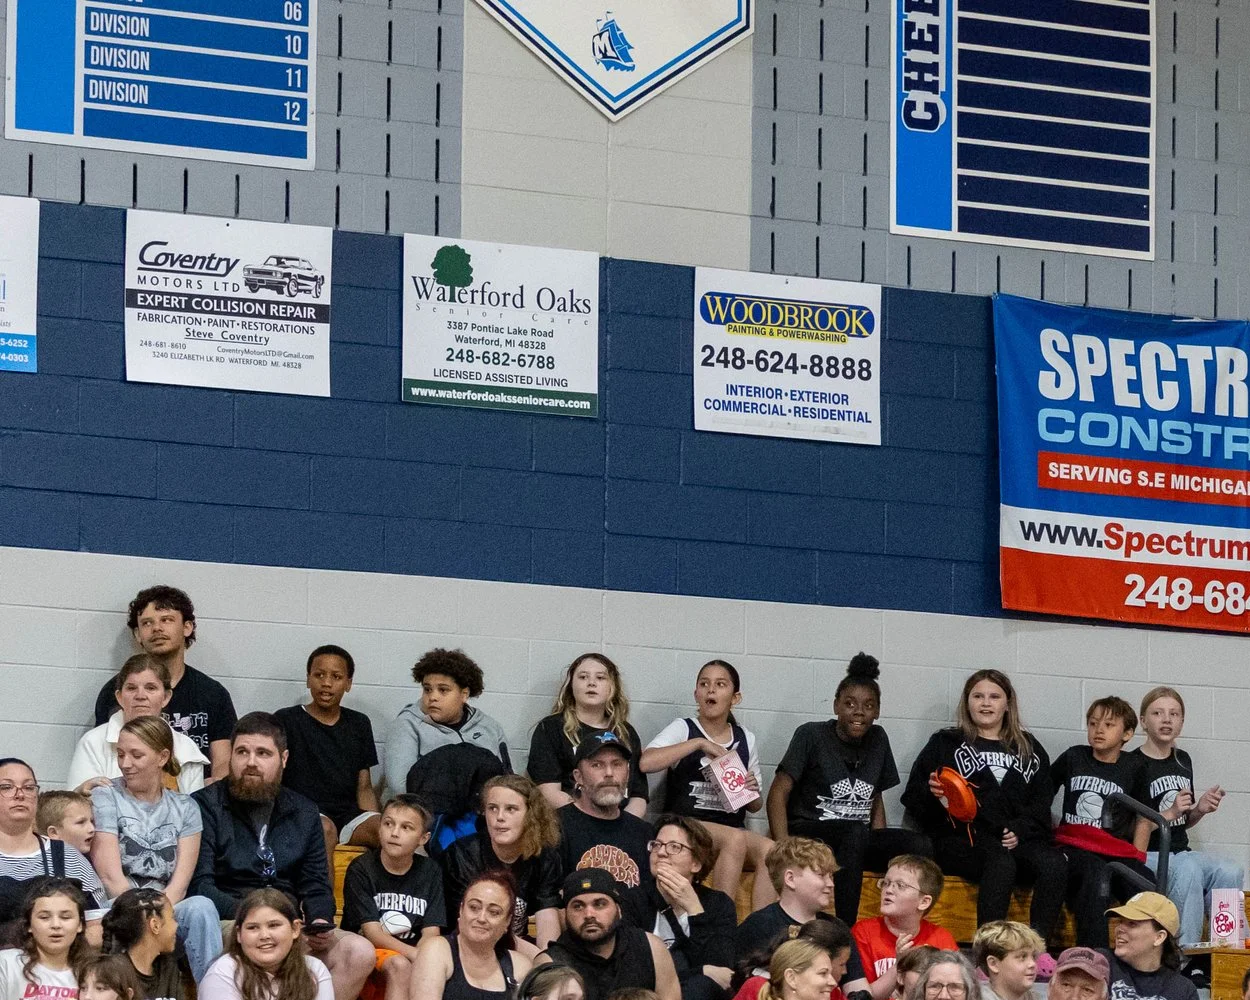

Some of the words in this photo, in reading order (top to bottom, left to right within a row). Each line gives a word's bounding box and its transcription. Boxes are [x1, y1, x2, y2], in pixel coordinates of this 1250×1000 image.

[284, 1, 302, 21] 06
[90, 11, 150, 37] DIVISION
[285, 34, 302, 55] 10
[90, 45, 150, 71] DIVISION
[285, 68, 302, 88] 11
[89, 79, 149, 105] DIVISION
[284, 101, 301, 122] 12
[138, 241, 240, 277] Coventry
[137, 275, 203, 290] MOTORS
[214, 282, 240, 293] LTD
[137, 294, 188, 308] EXPERT
[192, 297, 266, 316] COLLISION
[270, 304, 316, 320] REPAIR
[536, 287, 592, 314] Oaks
[704, 295, 870, 336] WOODBROOK
[185, 328, 213, 339] Steve
[221, 331, 270, 345] Coventry
[446, 321, 468, 331] 3387
[471, 323, 504, 334] Pontiac
[507, 326, 529, 337] Lake
[531, 328, 554, 338] Road
[727, 324, 766, 336] PAINTING
[769, 328, 775, 336] &
[777, 330, 847, 343] POWERWASHING
[140, 340, 187, 351] 248-681-8610
[455, 335, 502, 348] Waterford,
[505, 339, 516, 348] MI
[518, 341, 546, 351] 48328
[152, 351, 169, 359] 3240
[170, 352, 204, 362] ELIZABETH
[229, 357, 268, 367] WATERFORD
[446, 348, 555, 370] 248-682-6788
[701, 345, 872, 381] 248-624-8888
[433, 368, 482, 381] LICENSED
[485, 373, 533, 385] ASSISTED
[536, 377, 568, 388] LIVING
[411, 386, 591, 410] www.waterfordoaksseniorcare.com
[1048, 462, 1132, 486] SERVING
[1137, 471, 1166, 489] S.E
